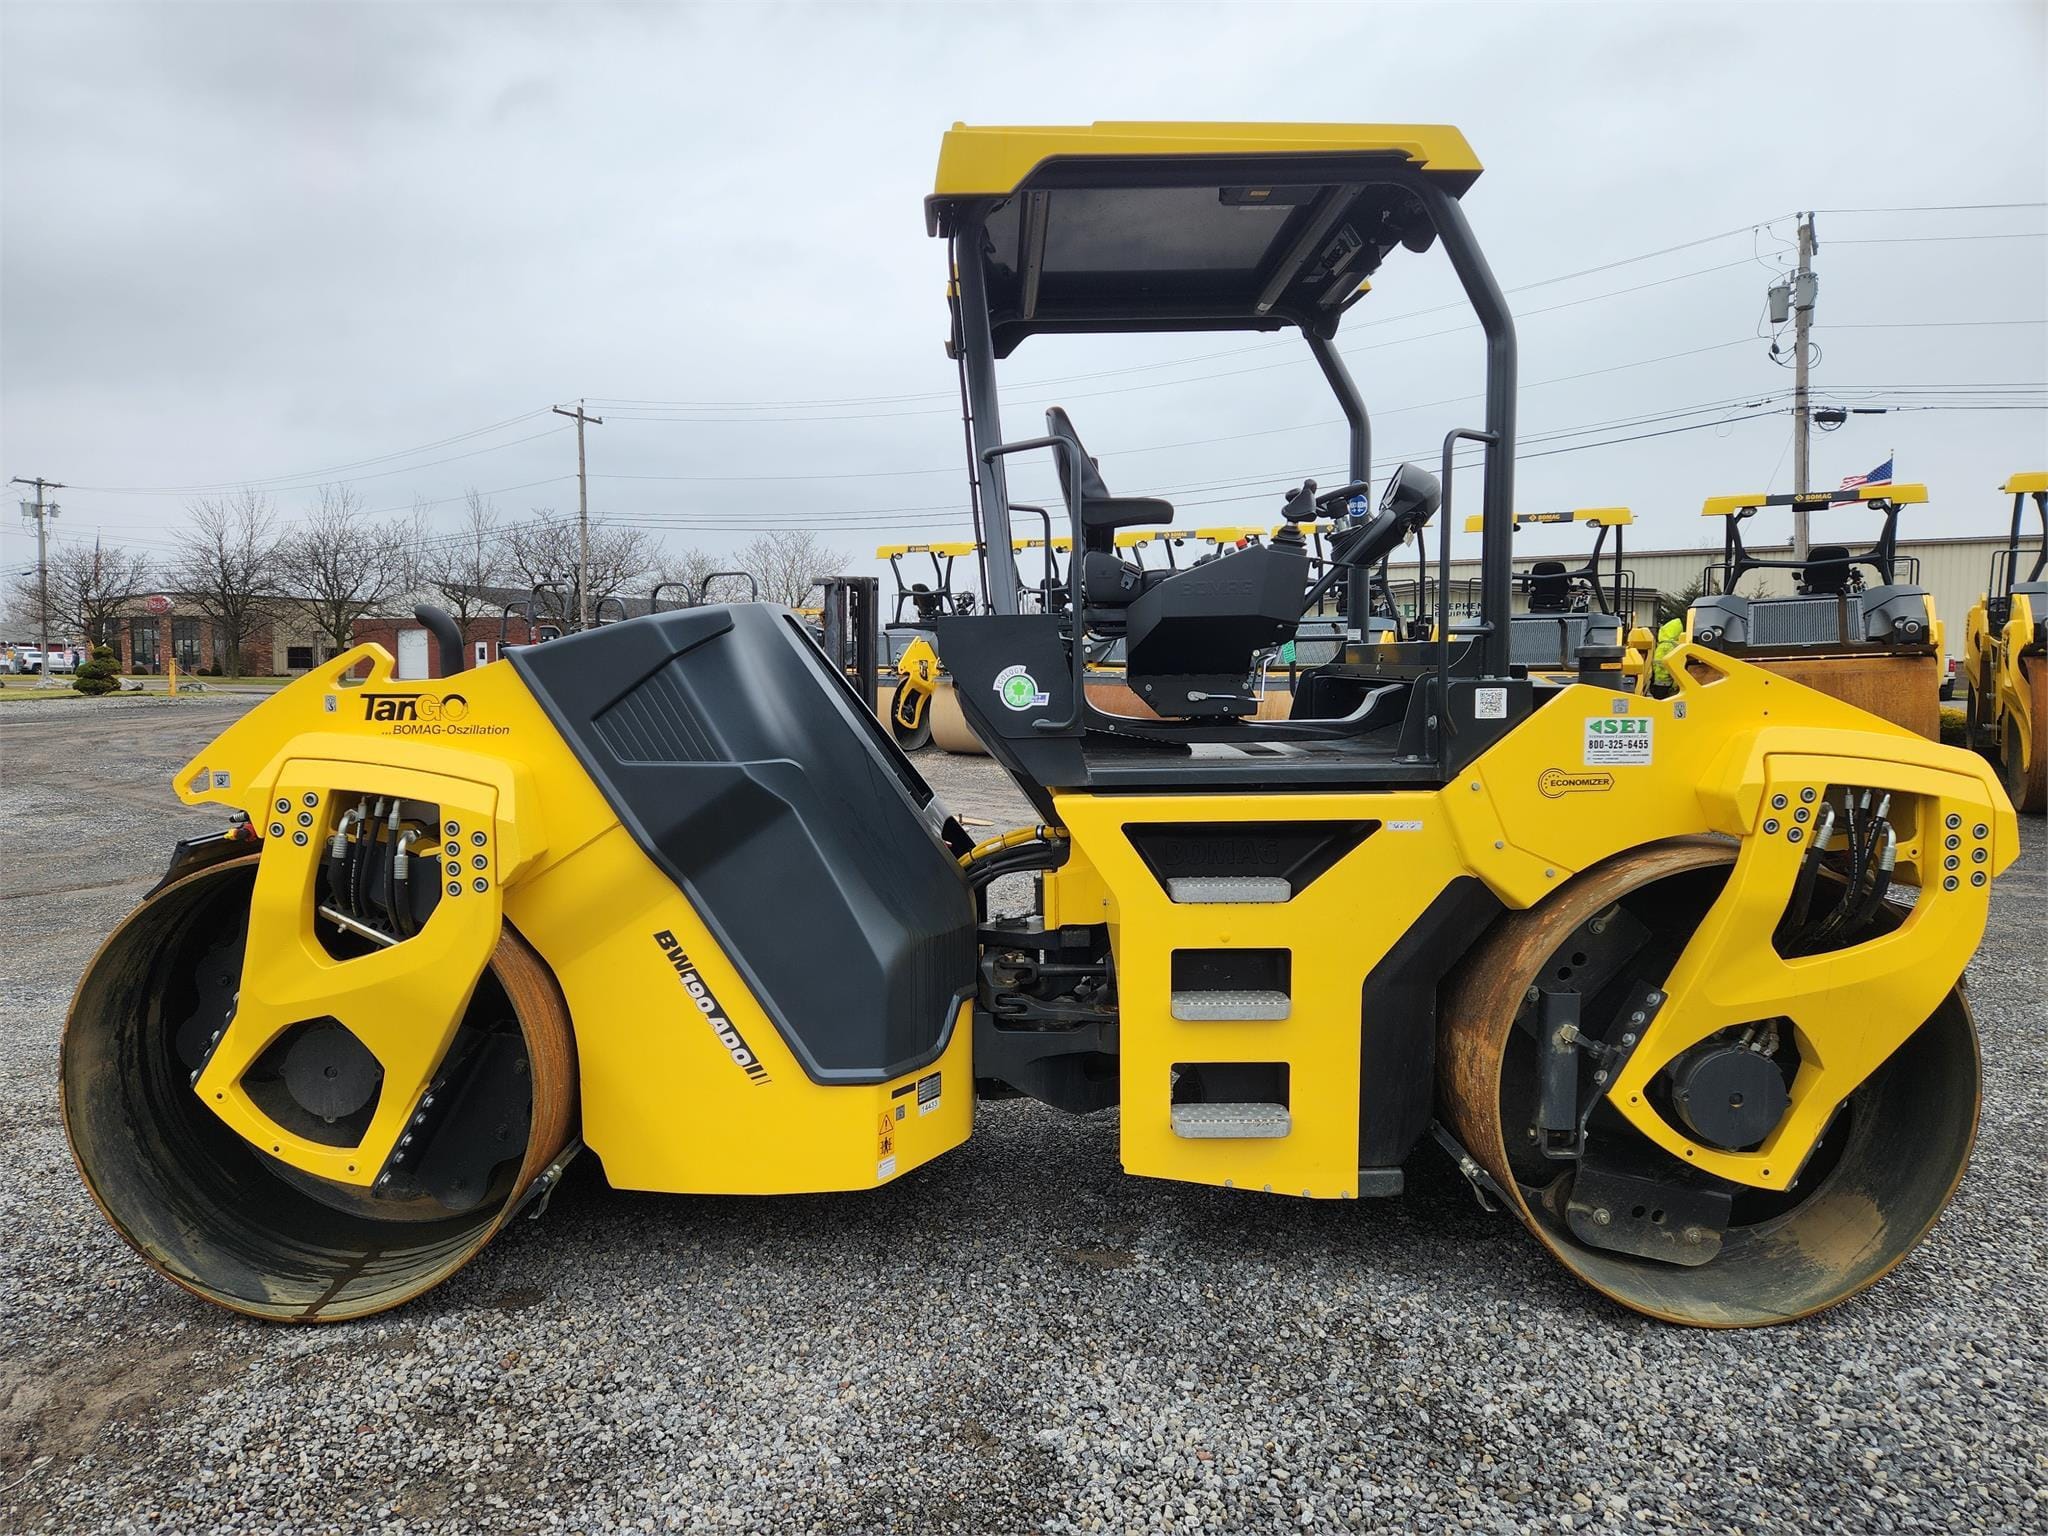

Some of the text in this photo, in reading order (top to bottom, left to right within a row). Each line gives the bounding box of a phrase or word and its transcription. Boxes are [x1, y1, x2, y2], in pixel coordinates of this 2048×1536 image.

[996, 666, 1024, 689] ECOLOGY
[1603, 719, 1649, 734] SEI
[1588, 739, 1649, 749] 800-325-6455
[1550, 778, 1610, 787] ECONOMIZER
